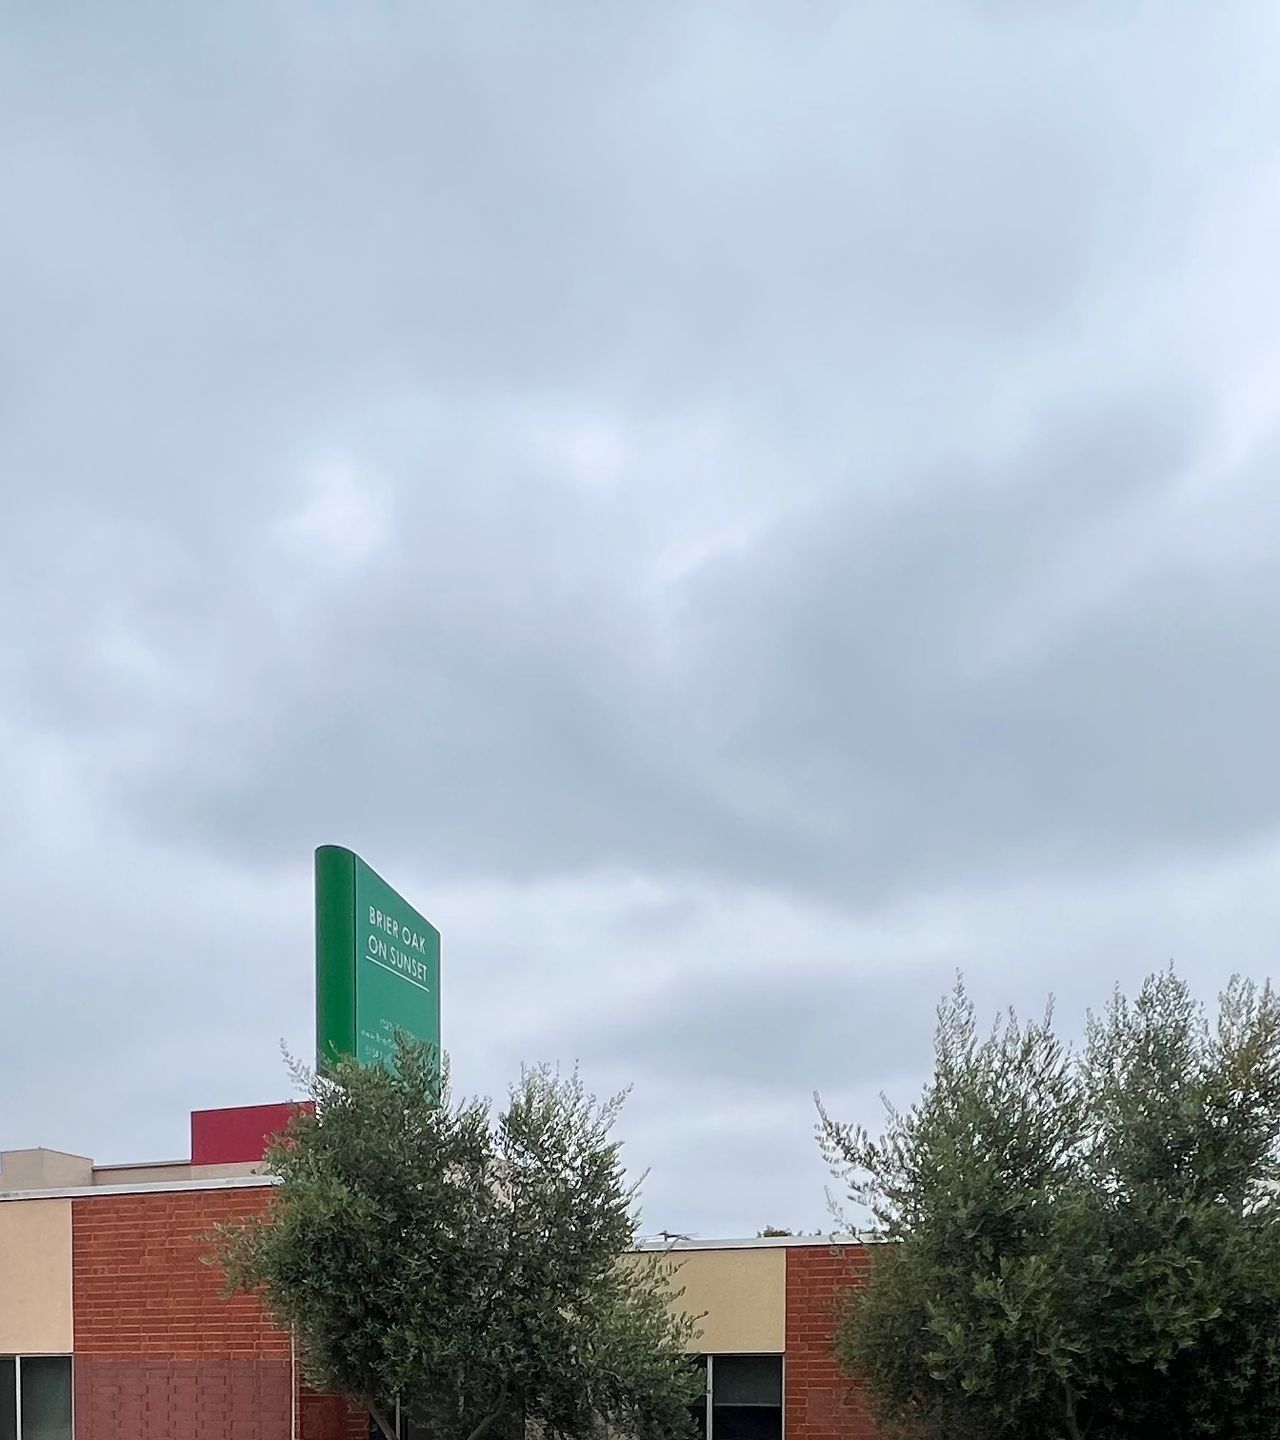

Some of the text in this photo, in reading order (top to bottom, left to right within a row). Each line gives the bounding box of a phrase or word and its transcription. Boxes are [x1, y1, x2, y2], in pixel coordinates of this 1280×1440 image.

[369, 905, 426, 956] BRIER OAK
[368, 934, 428, 982] ON SUNSET
